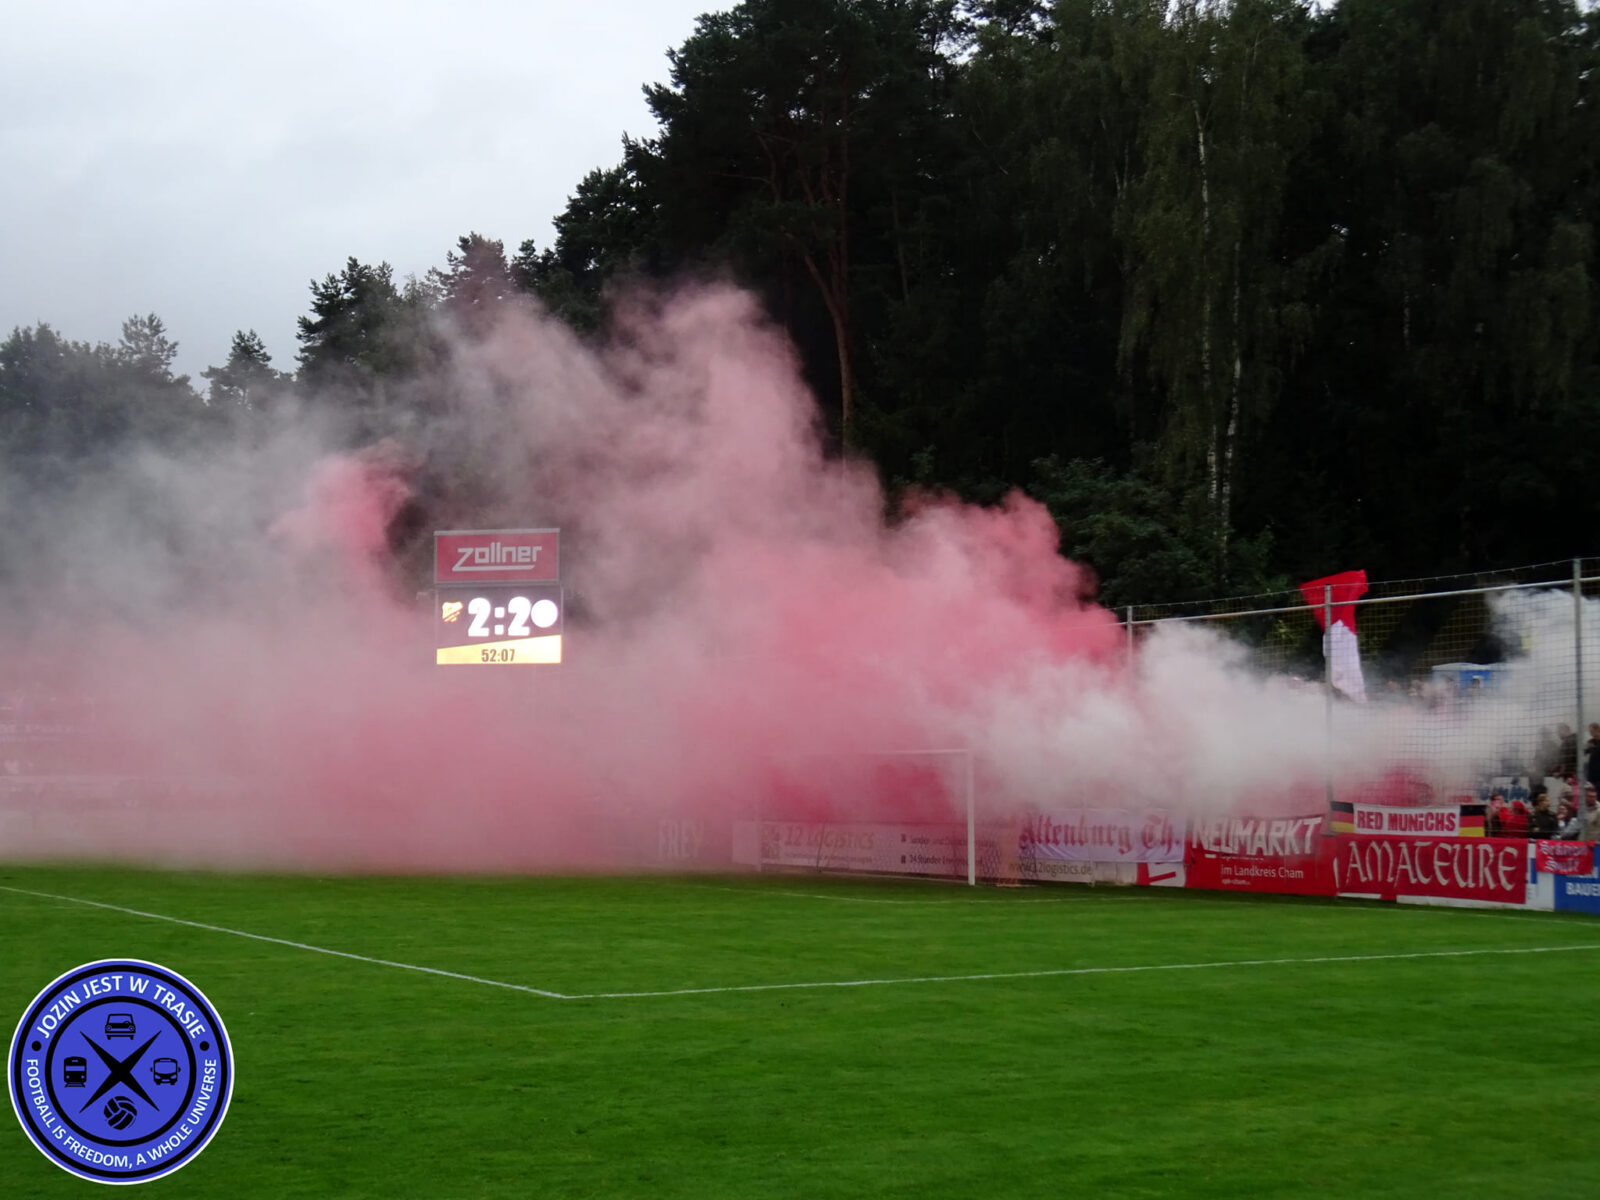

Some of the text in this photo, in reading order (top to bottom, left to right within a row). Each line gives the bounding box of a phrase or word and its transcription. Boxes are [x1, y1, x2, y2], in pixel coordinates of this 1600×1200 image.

[452, 542, 542, 571] zollner
[468, 596, 531, 637] 2:2
[481, 648, 515, 662] 52:07
[1356, 811, 1383, 830] RED
[1191, 816, 1322, 857] NEUMARKT
[1234, 864, 1277, 878] Landkreis
[1278, 866, 1304, 879] Cham
[1345, 840, 1518, 890] AMATEURE
[1566, 882, 1600, 897] BAUE
